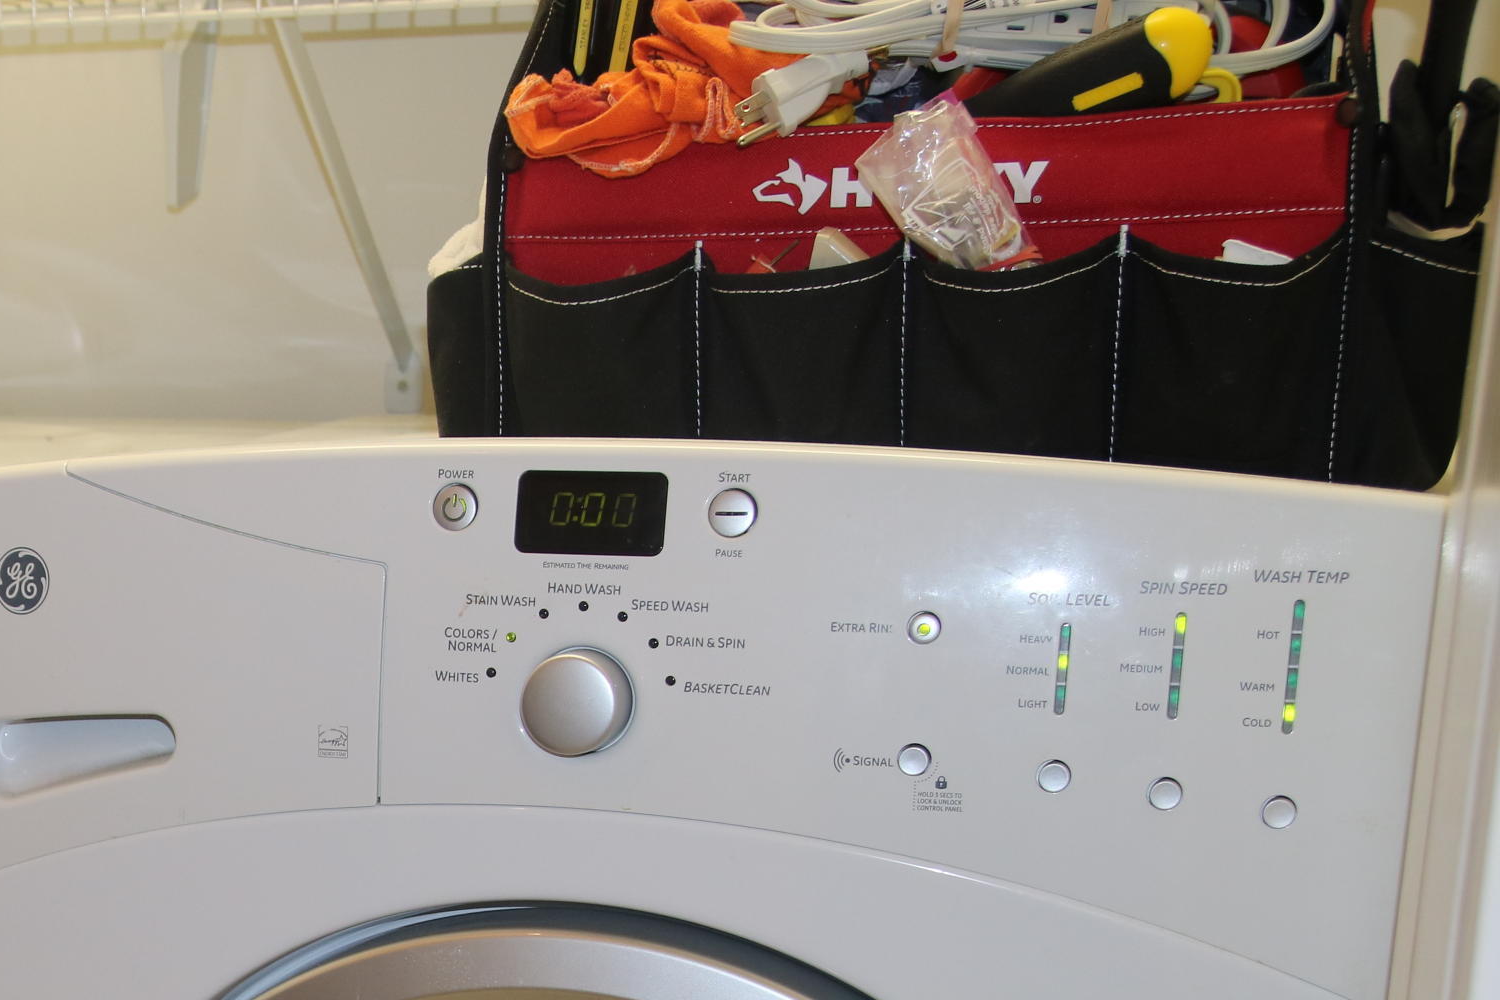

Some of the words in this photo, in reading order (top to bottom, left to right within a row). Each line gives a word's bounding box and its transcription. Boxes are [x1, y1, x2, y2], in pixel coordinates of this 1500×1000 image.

[437, 469, 475, 479] POWER
[718, 472, 751, 484] START
[715, 549, 743, 559] PAUSE
[542, 561, 576, 570] ESTIMATED
[577, 562, 592, 570] TIME
[594, 562, 629, 571] REMAINING
[1253, 569, 1302, 583] WASH
[1307, 570, 1350, 584] TEMP
[547, 582, 582, 594] HAND
[585, 583, 621, 595] WASH
[1139, 580, 1175, 595] SPIN
[1178, 581, 1228, 595] SPEED
[466, 594, 498, 606] STAIN
[500, 595, 536, 607] WASH
[631, 598, 668, 612] SPEED
[671, 600, 709, 613] WASH
[1065, 592, 1111, 607] LEVEL
[830, 621, 866, 633] EXTRA
[1139, 626, 1166, 637] HIGH
[1019, 634, 1053, 644] HEAVY
[1256, 629, 1280, 640] HOT
[448, 640, 497, 653] NORMAL
[665, 634, 704, 648] DRAIN
[706, 636, 716, 648] &
[717, 636, 746, 649] SPIN
[1006, 665, 1050, 676] NORMAL
[1119, 663, 1163, 673] MEDIUM
[435, 670, 479, 683] WHITES
[683, 681, 771, 697] BASKETCLEAN
[1239, 682, 1275, 692] WARM
[1018, 698, 1048, 709] LIGHT
[1135, 701, 1160, 712] LOW
[1242, 717, 1272, 728] COLD
[853, 755, 894, 767] SIGNAL
